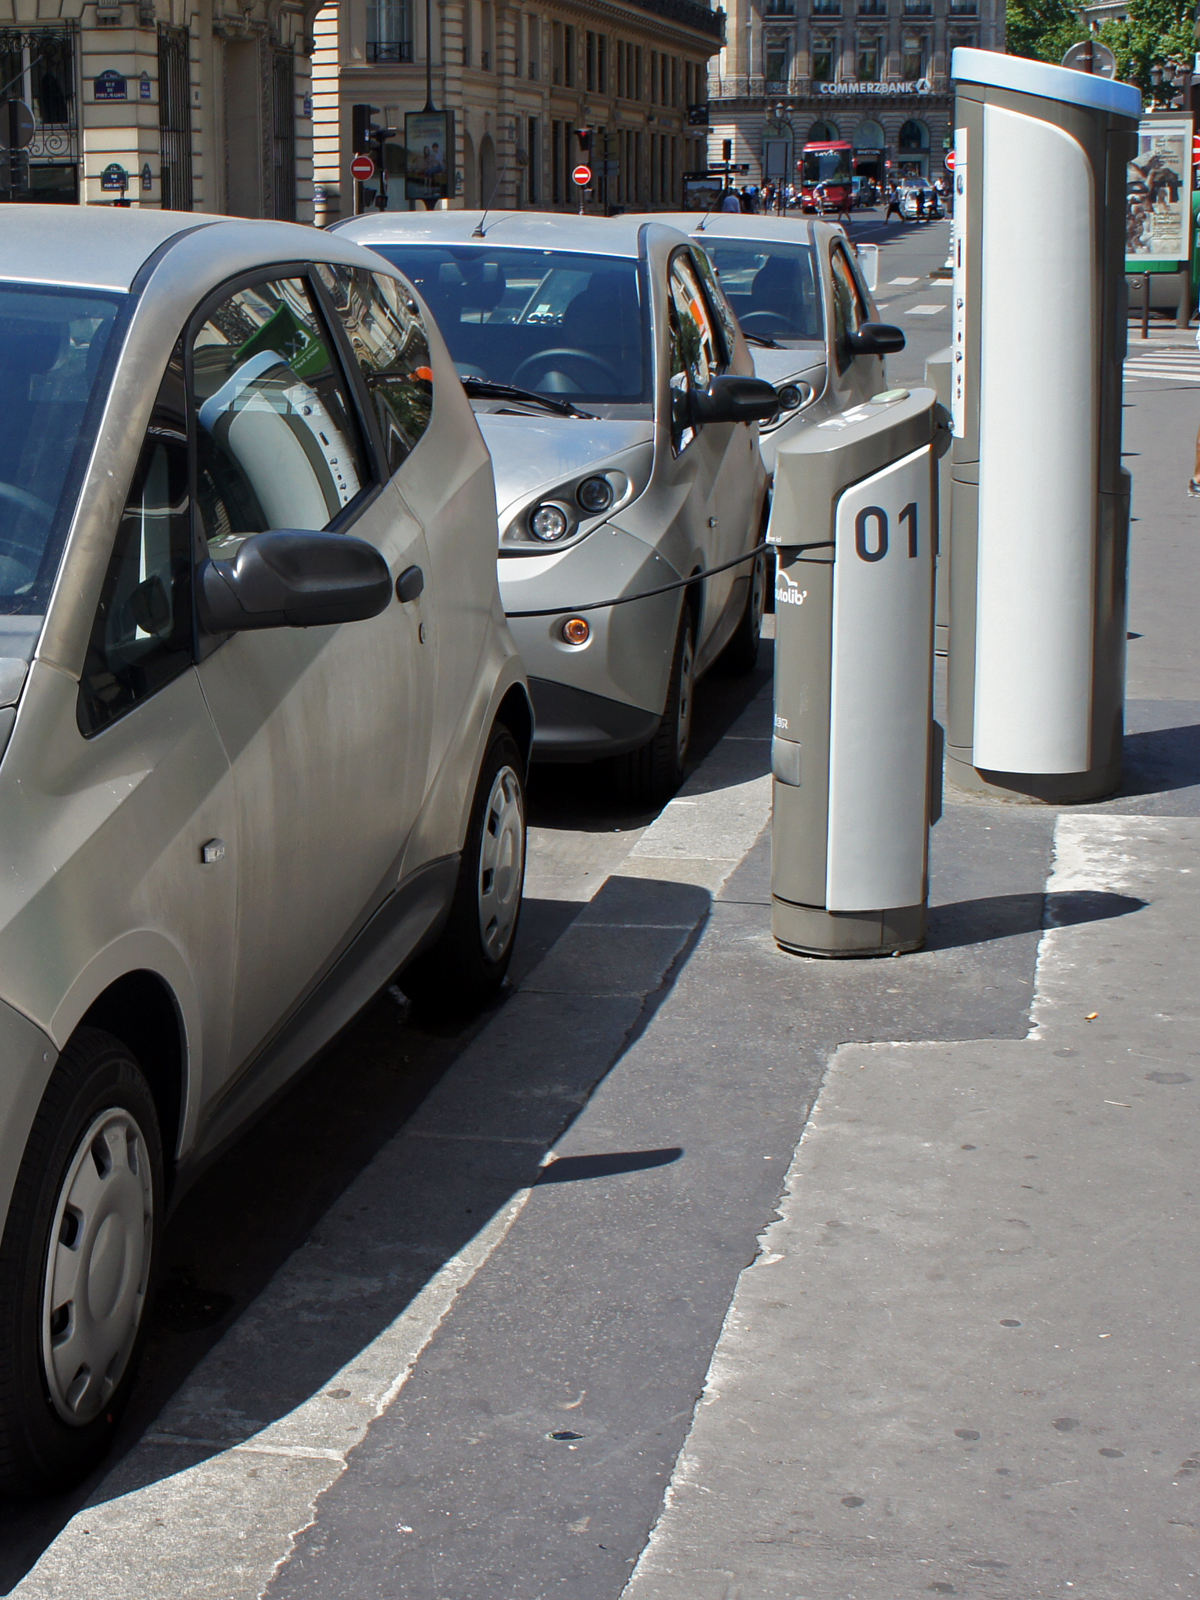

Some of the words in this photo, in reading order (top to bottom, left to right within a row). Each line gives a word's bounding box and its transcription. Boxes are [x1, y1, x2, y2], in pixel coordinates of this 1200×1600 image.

[820, 82, 913, 94] COMMERZBANK
[854, 502, 919, 563] 01
[775, 588, 808, 606] utolib'
